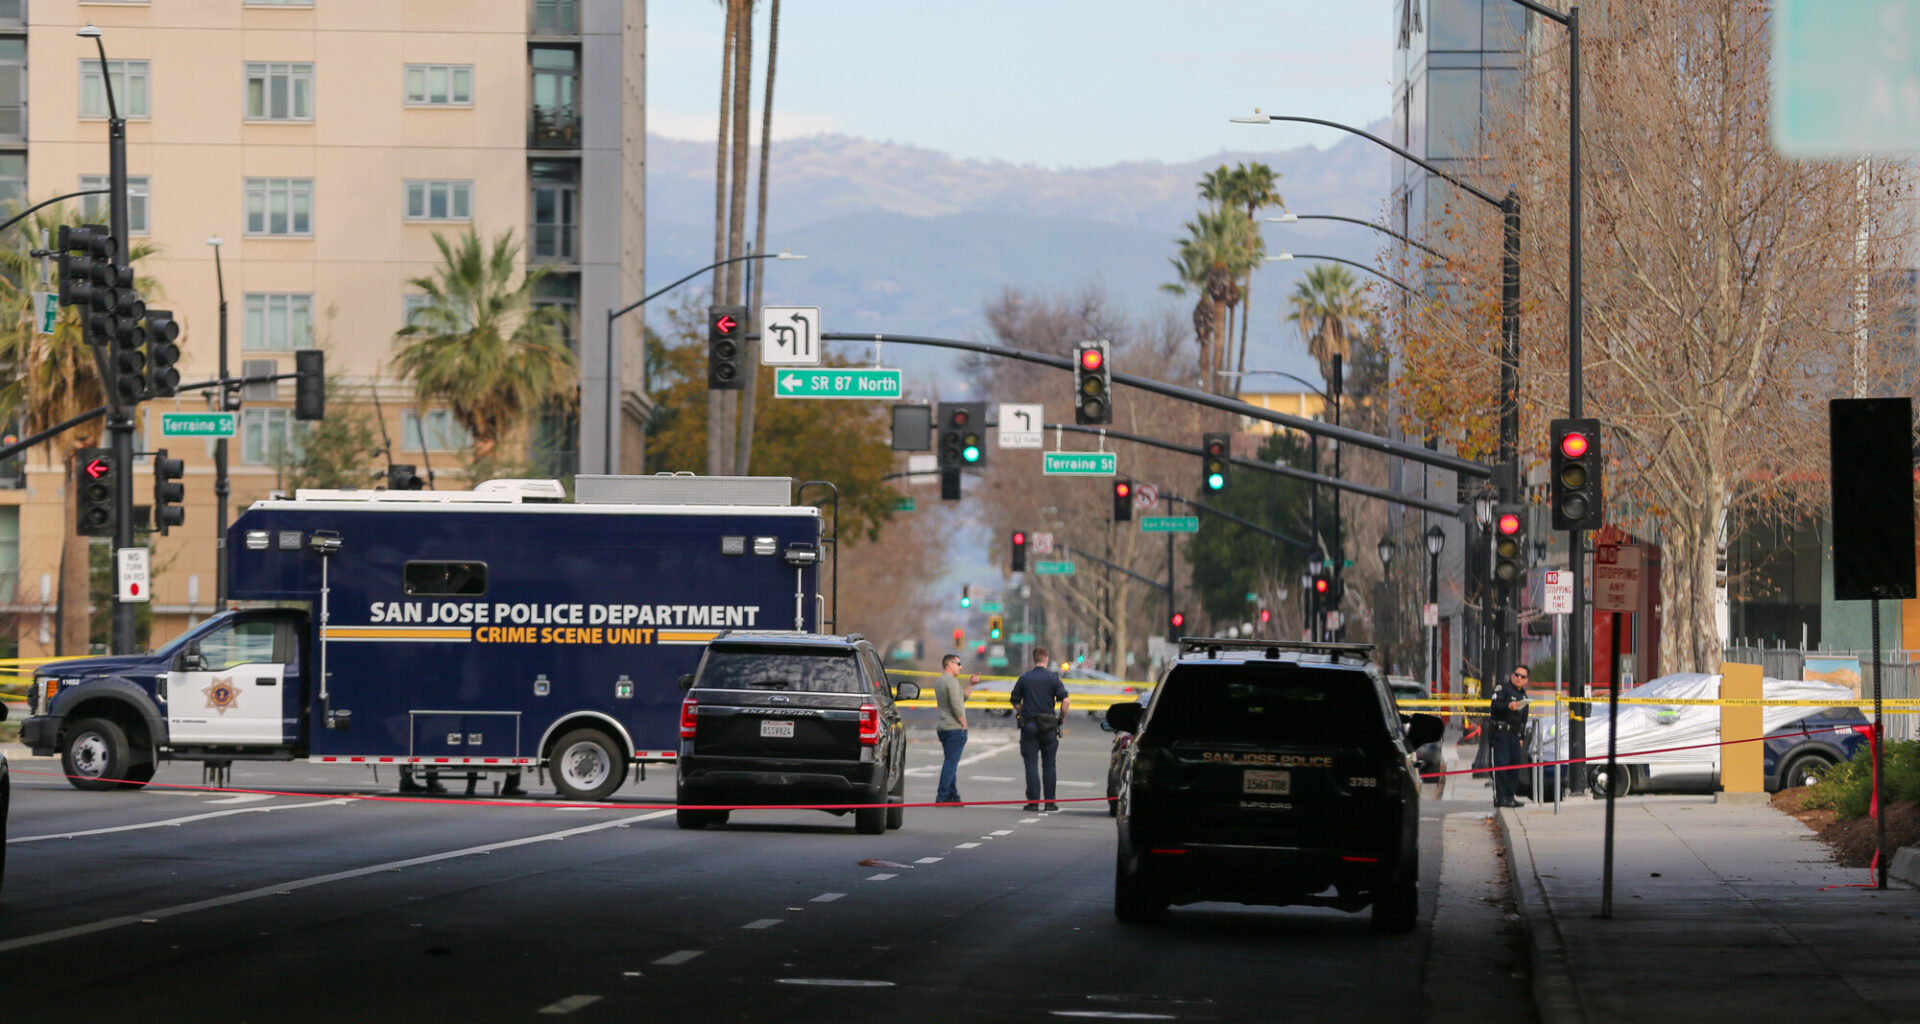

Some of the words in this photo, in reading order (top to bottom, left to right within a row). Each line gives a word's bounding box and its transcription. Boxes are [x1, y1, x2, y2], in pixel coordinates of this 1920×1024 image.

[811, 376, 829, 390] SR
[835, 376, 852, 390] 87
[858, 376, 897, 391] North
[164, 418, 215, 432] Terraine
[219, 418, 233, 431] St
[1047, 457, 1097, 470] Terraine
[1101, 458, 1113, 470] St
[1600, 546, 1617, 562] NO
[1547, 573, 1558, 583] NO
[1598, 566, 1638, 580] STOPPING
[1545, 585, 1572, 594] STOPPING
[1609, 582, 1626, 591] ANY
[1607, 593, 1626, 604] TIME
[370, 602, 422, 623] SAN
[427, 602, 489, 623] JOSE
[495, 603, 583, 624] POLICE
[589, 604, 760, 626] DEPARTMENT
[475, 626, 538, 643] CRIME
[541, 627, 603, 644] SCENE
[607, 627, 655, 644] UNIT
[742, 708, 814, 716] EXPEDITION
[1202, 752, 1234, 763] SAN
[1238, 753, 1276, 765] JOSE
[1280, 754, 1333, 768] POLICE
